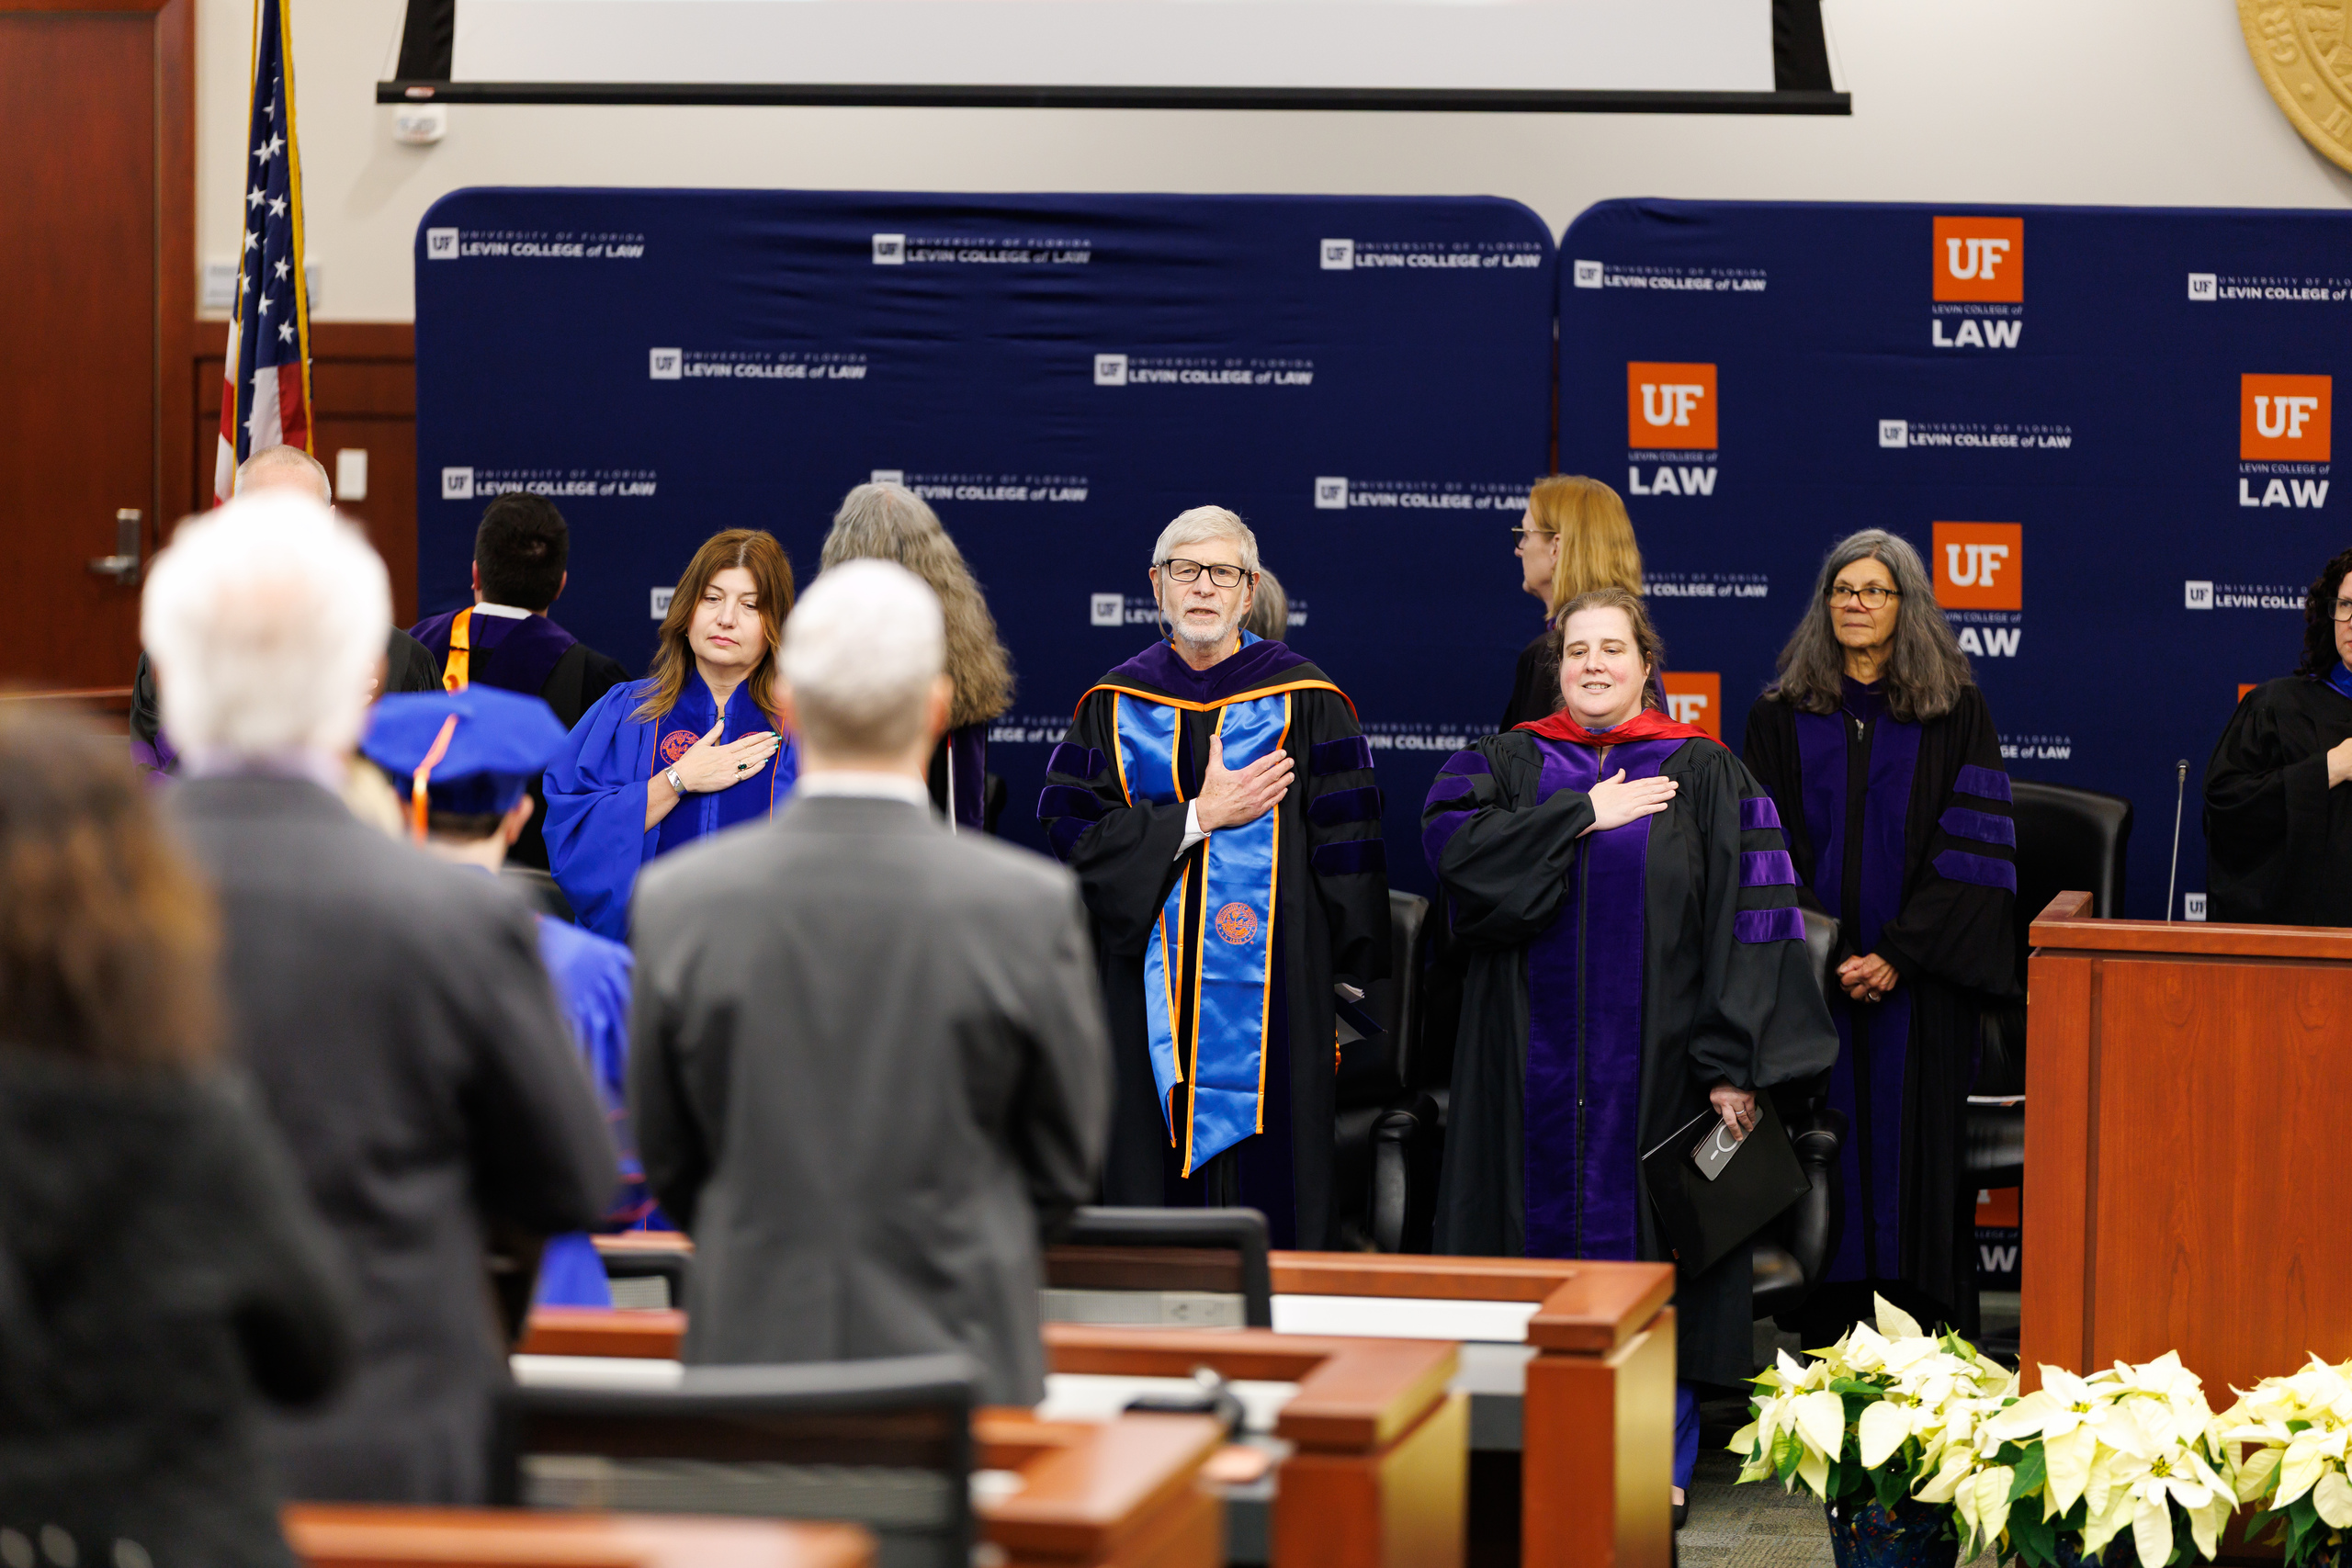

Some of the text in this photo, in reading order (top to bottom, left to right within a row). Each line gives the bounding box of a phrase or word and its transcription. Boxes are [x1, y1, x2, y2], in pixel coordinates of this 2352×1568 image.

[460, 242, 645, 258] LEVIN COLLEGE of LAW
[906, 249, 1091, 264] LEVIN COLLEGE of LAW
[1354, 254, 1542, 268] LEVIN COLLEGE of LAW
[1946, 238, 2010, 280] UF
[1604, 274, 1768, 292] LEVIN COLLEGE of LAW
[2219, 287, 2347, 301] LEVIN COLLEGE of
[1931, 304, 2023, 315] LEVIN COLLEGE of
[1932, 319, 2023, 348] LAW
[684, 362, 867, 379] LEVIN COLLEGE of LAW
[1128, 368, 1314, 385] LEVIN COLLEGE of LAW
[1640, 383, 1704, 426] UF
[2254, 395, 2318, 438] UF
[1908, 433, 2072, 449] LEVIN COLLEGE of LAW
[1628, 451, 1718, 462] LEVIN COLLEGE of
[2239, 463, 2330, 475] LEVIN COLLEGE of
[475, 480, 657, 497] LEVIN COLLEGE of LAW
[1629, 466, 1718, 496] LAW
[955, 485, 1028, 501] COLLEGE
[1029, 486, 1047, 502] of
[1048, 487, 1088, 502] LAW
[1349, 491, 1530, 510] LEVIN COLLEGE of LAW
[2239, 478, 2330, 508] LAW
[1945, 544, 2009, 587] UF
[1652, 583, 1716, 597] COLLEGE
[1717, 584, 1734, 597] of
[1734, 584, 1769, 597] LAW
[2215, 594, 2258, 608] LEVIN
[1963, 612, 2008, 623] COLLEGE
[2010, 613, 2021, 624] of
[1026, 728, 1046, 743] of
[1394, 735, 1468, 751] COLLEGE
[2020, 745, 2036, 760] of
[2037, 745, 2072, 760] LAW
[2007, 1230, 2018, 1240] of
